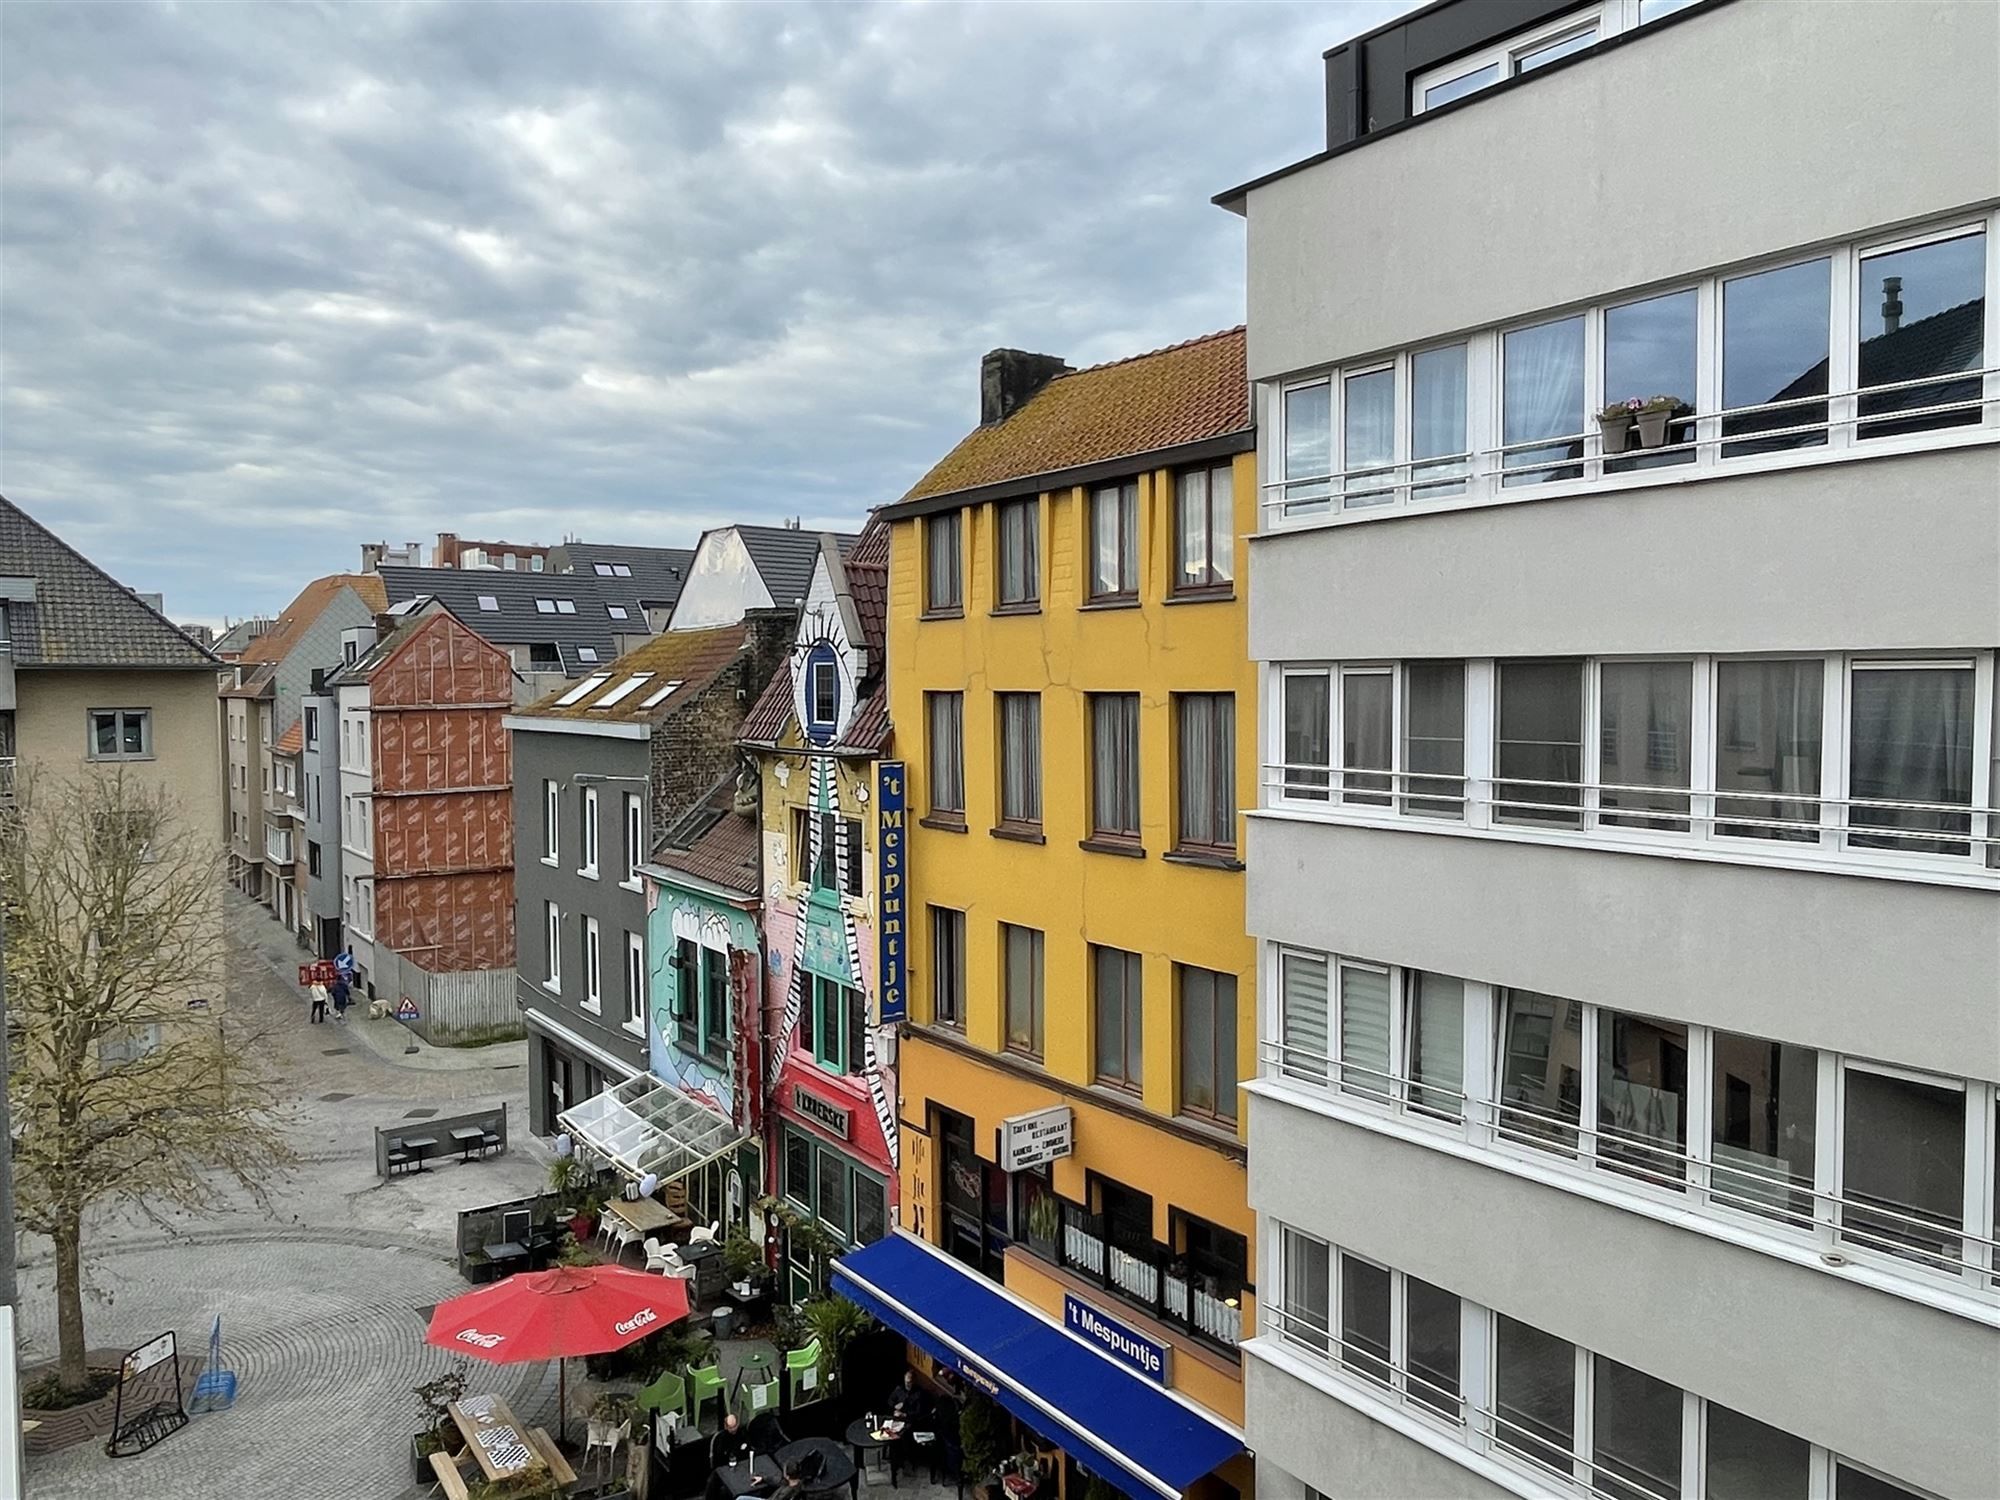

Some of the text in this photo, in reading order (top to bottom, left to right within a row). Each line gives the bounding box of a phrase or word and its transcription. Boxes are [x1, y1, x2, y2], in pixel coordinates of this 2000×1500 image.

[881, 776, 902, 1003] 't Mespuntje
[1032, 1122, 1068, 1139] RESTAURANT
[1069, 1302, 1160, 1371] 't Mespuntje
